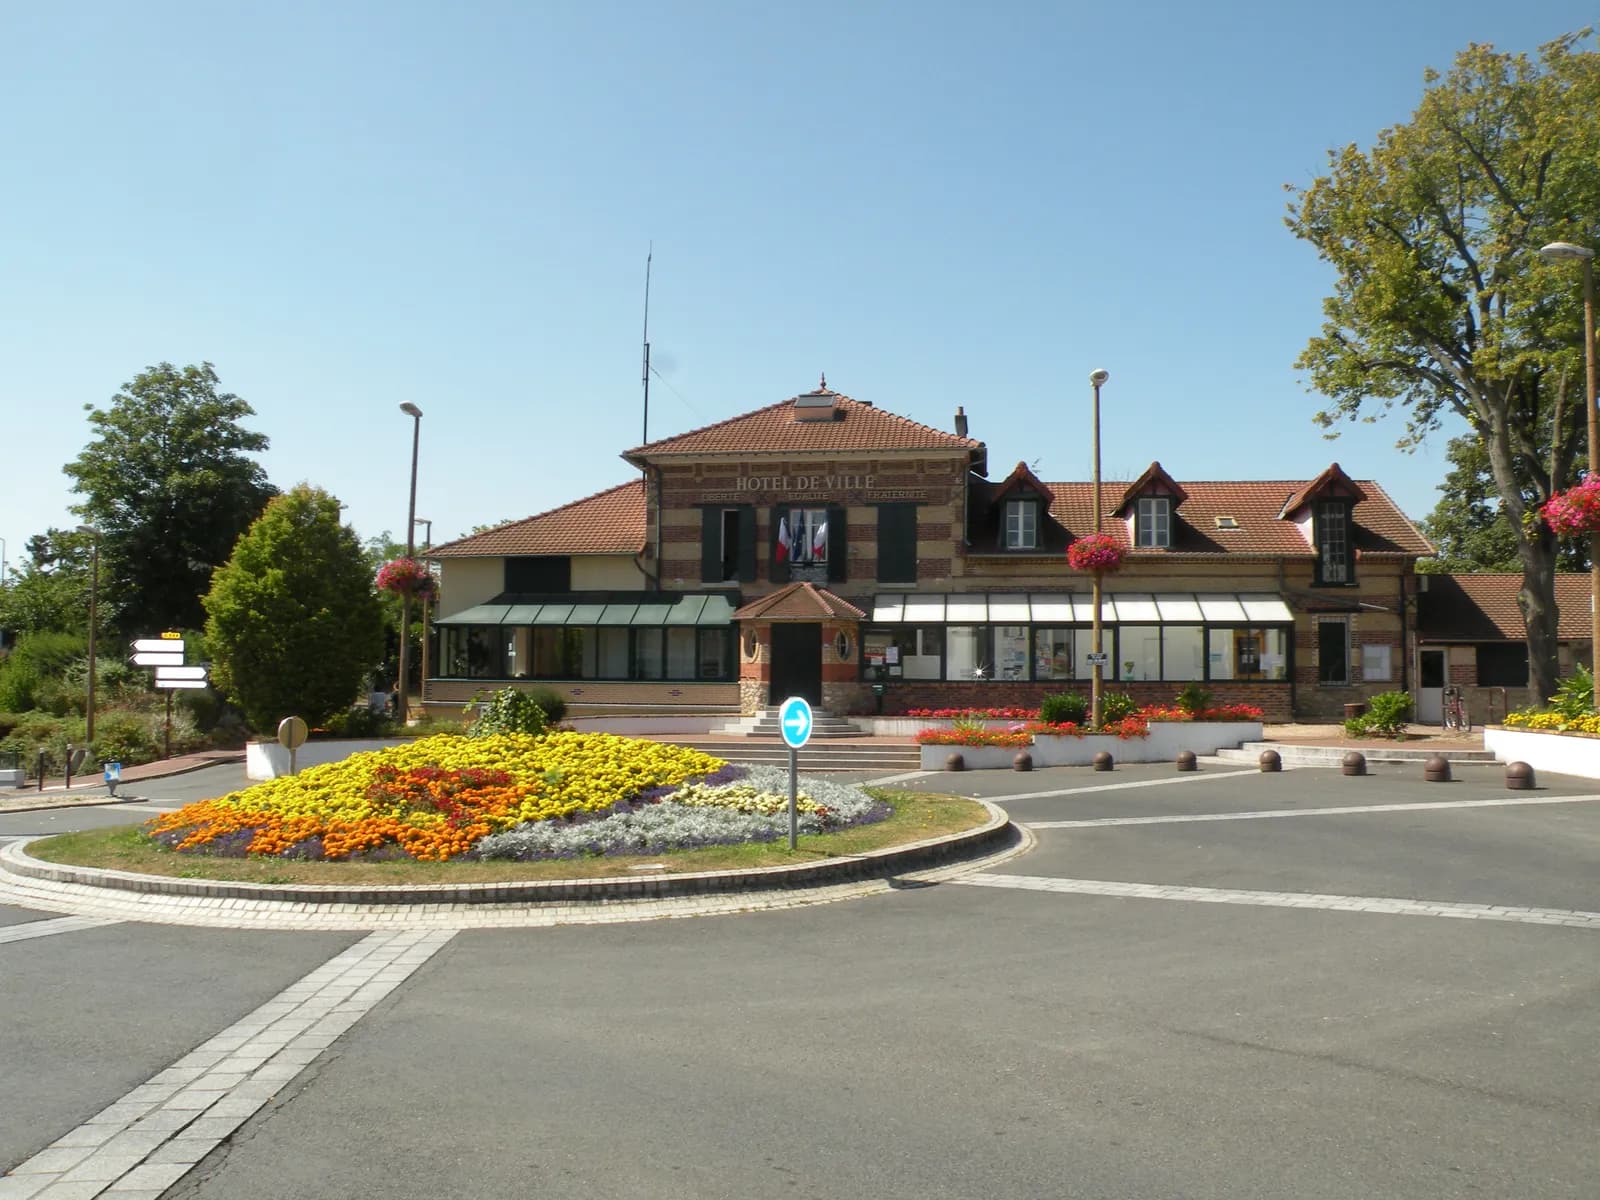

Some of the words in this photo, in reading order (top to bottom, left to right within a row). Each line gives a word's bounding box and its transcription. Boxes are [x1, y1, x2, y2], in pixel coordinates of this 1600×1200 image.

[736, 476, 792, 491] HOTEL
[797, 476, 819, 490] DE
[824, 475, 875, 489] VILLE
